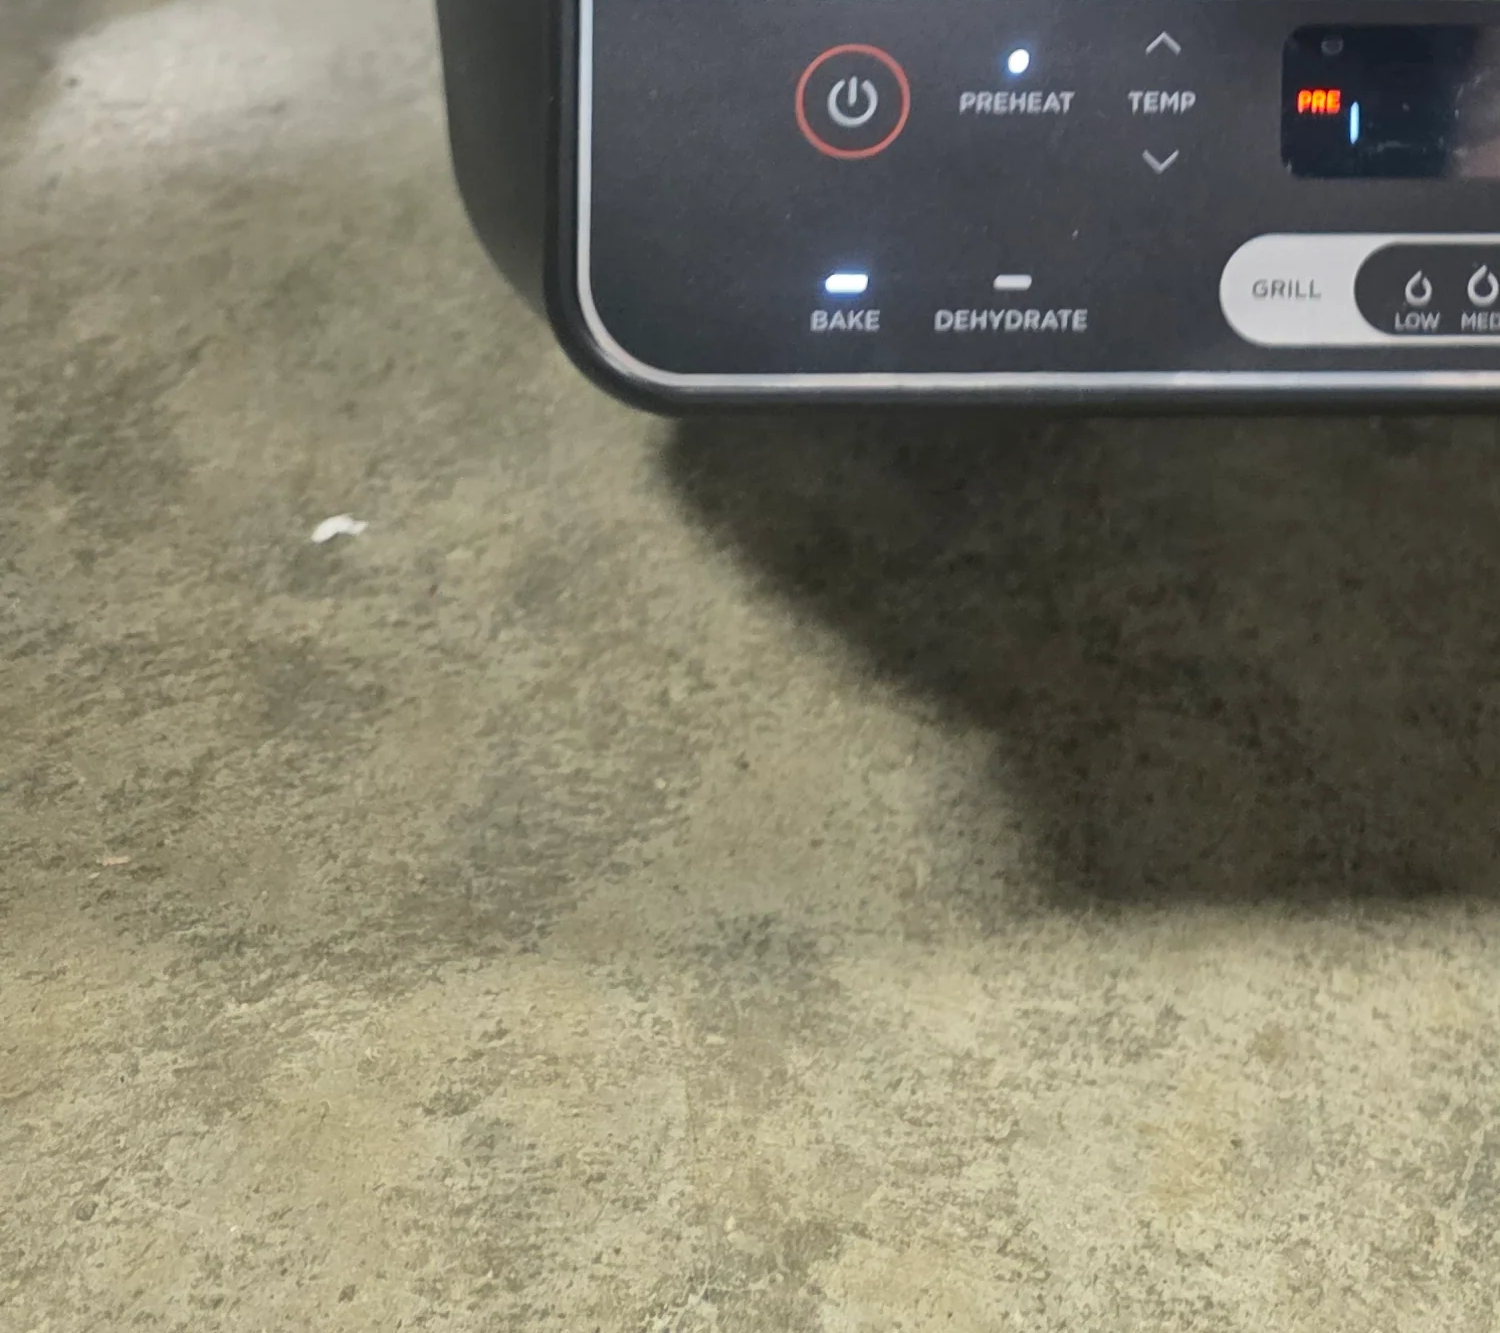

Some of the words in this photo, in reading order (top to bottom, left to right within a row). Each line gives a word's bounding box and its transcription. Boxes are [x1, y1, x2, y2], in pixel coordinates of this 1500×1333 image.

[958, 91, 1075, 115] PREHEAT
[1127, 91, 1196, 114] TEMP
[1297, 89, 1342, 115] PRE
[1251, 278, 1322, 300] GRILL
[810, 309, 881, 332] BAKE
[934, 309, 1089, 333] DEHYDRATE
[1394, 312, 1440, 330] LOW
